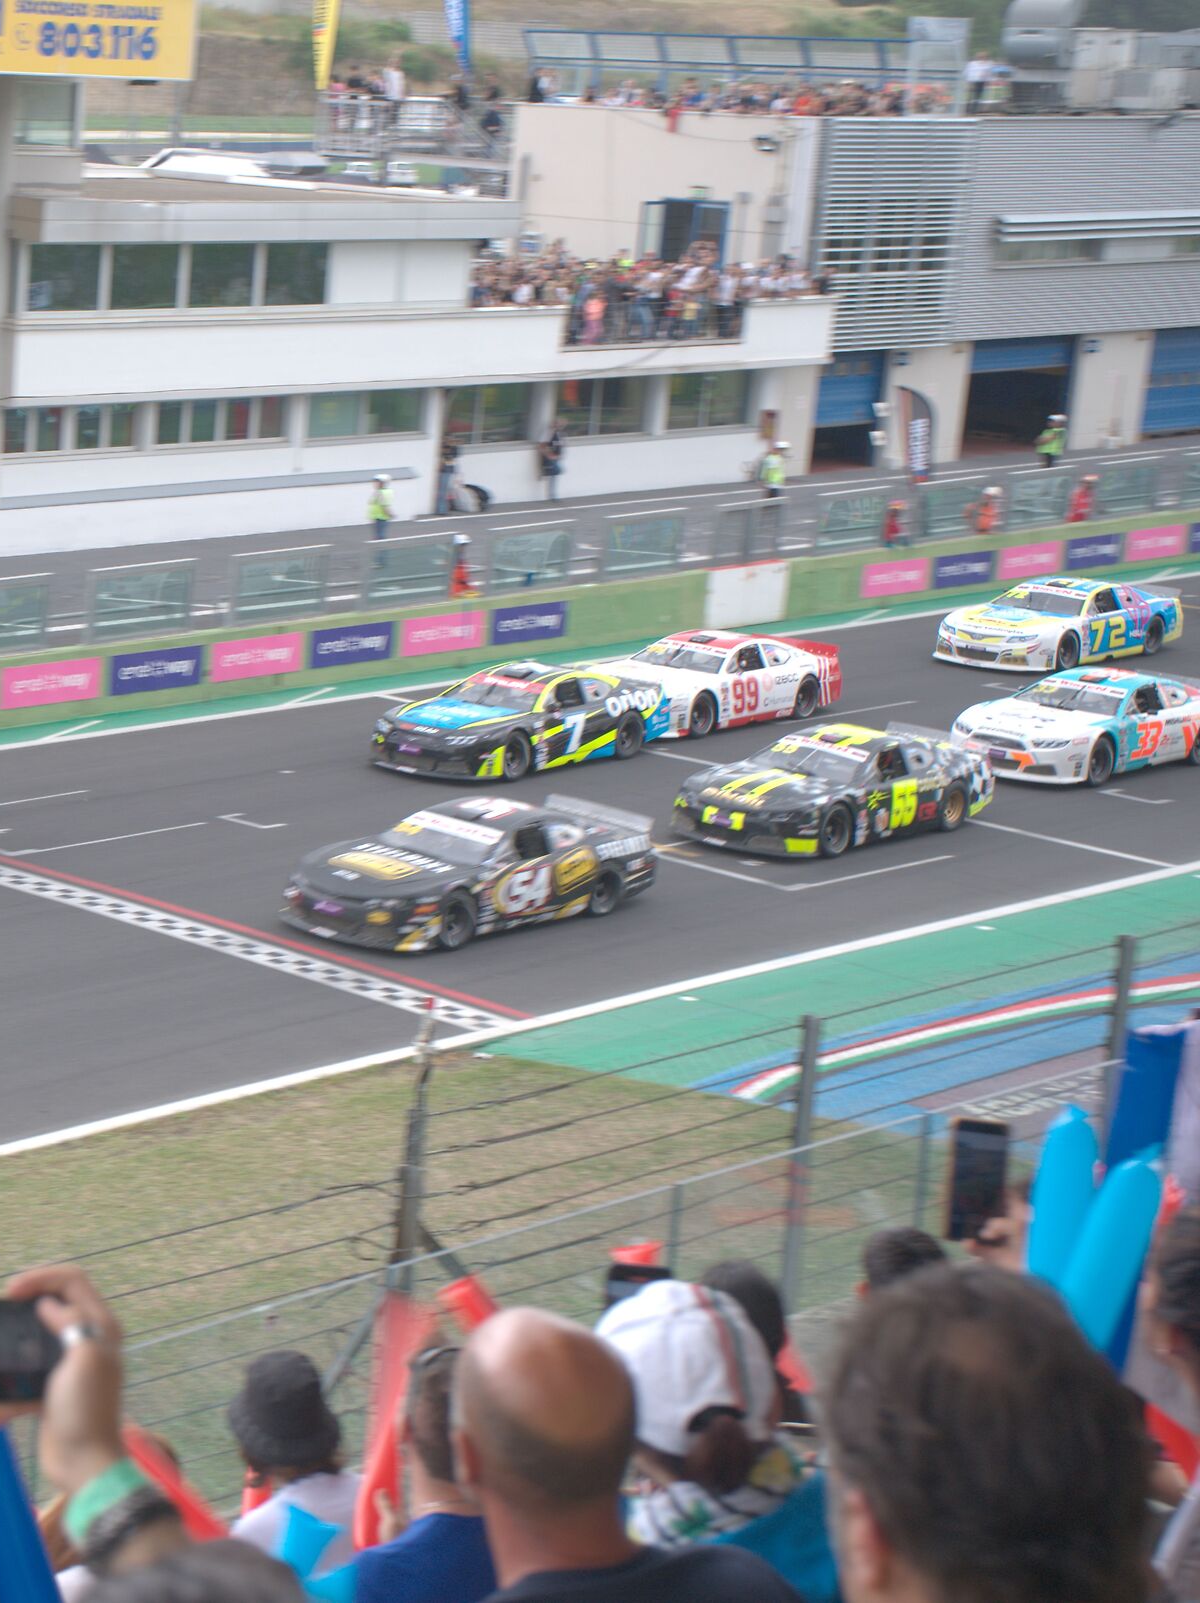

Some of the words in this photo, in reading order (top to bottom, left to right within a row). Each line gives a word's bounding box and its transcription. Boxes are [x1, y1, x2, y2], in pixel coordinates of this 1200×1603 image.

[1091, 616, 1126, 652] 72
[731, 676, 760, 714] 99
[563, 713, 586, 755] 7
[1130, 721, 1163, 759] 33
[504, 866, 552, 915] 54
